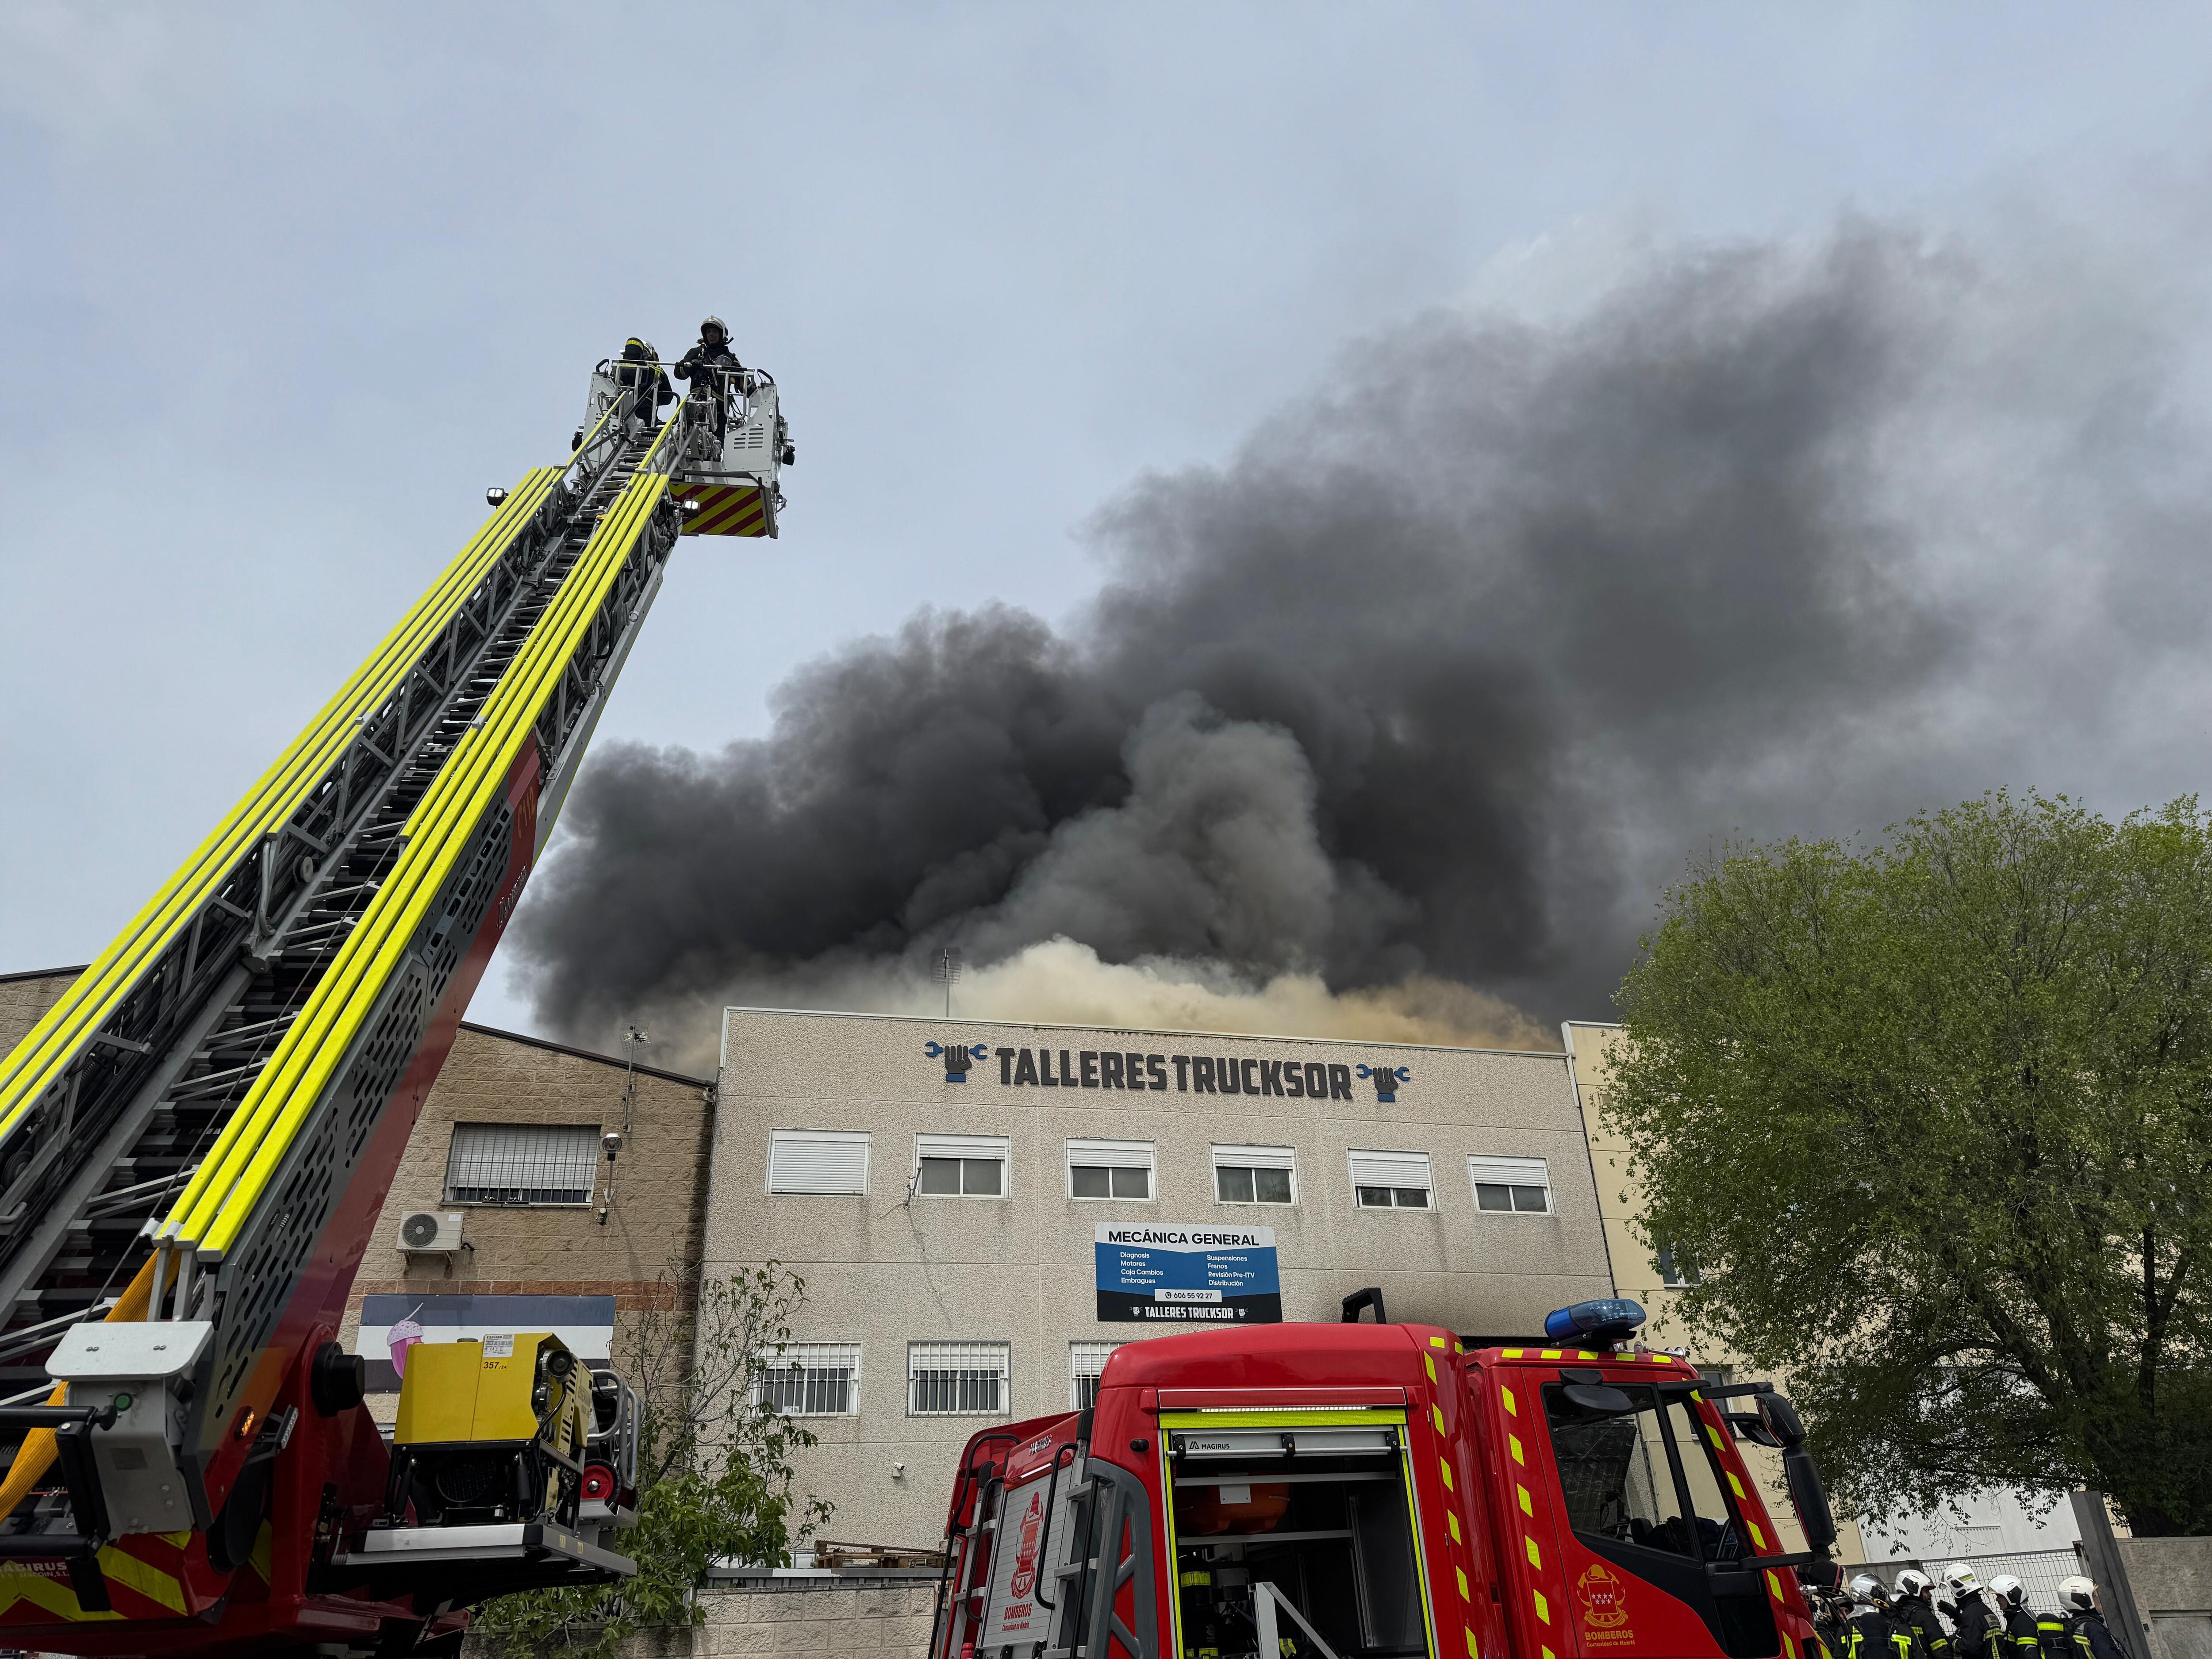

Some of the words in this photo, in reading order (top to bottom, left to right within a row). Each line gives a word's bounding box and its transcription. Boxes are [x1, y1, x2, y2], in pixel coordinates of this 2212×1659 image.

[995, 1048, 1167, 1089] TALLERES
[1171, 1055, 1353, 1099] TRUCKSOR
[1109, 1229, 1188, 1244] MECÁNICA
[1191, 1233, 1260, 1245] GENERAL
[1144, 1306, 1186, 1318] TALLERES
[1188, 1307, 1233, 1319] TRUCKSOR
[1004, 1602, 1032, 1620] BOMBEROS
[1585, 1630, 1634, 1640] BOMBEROS
